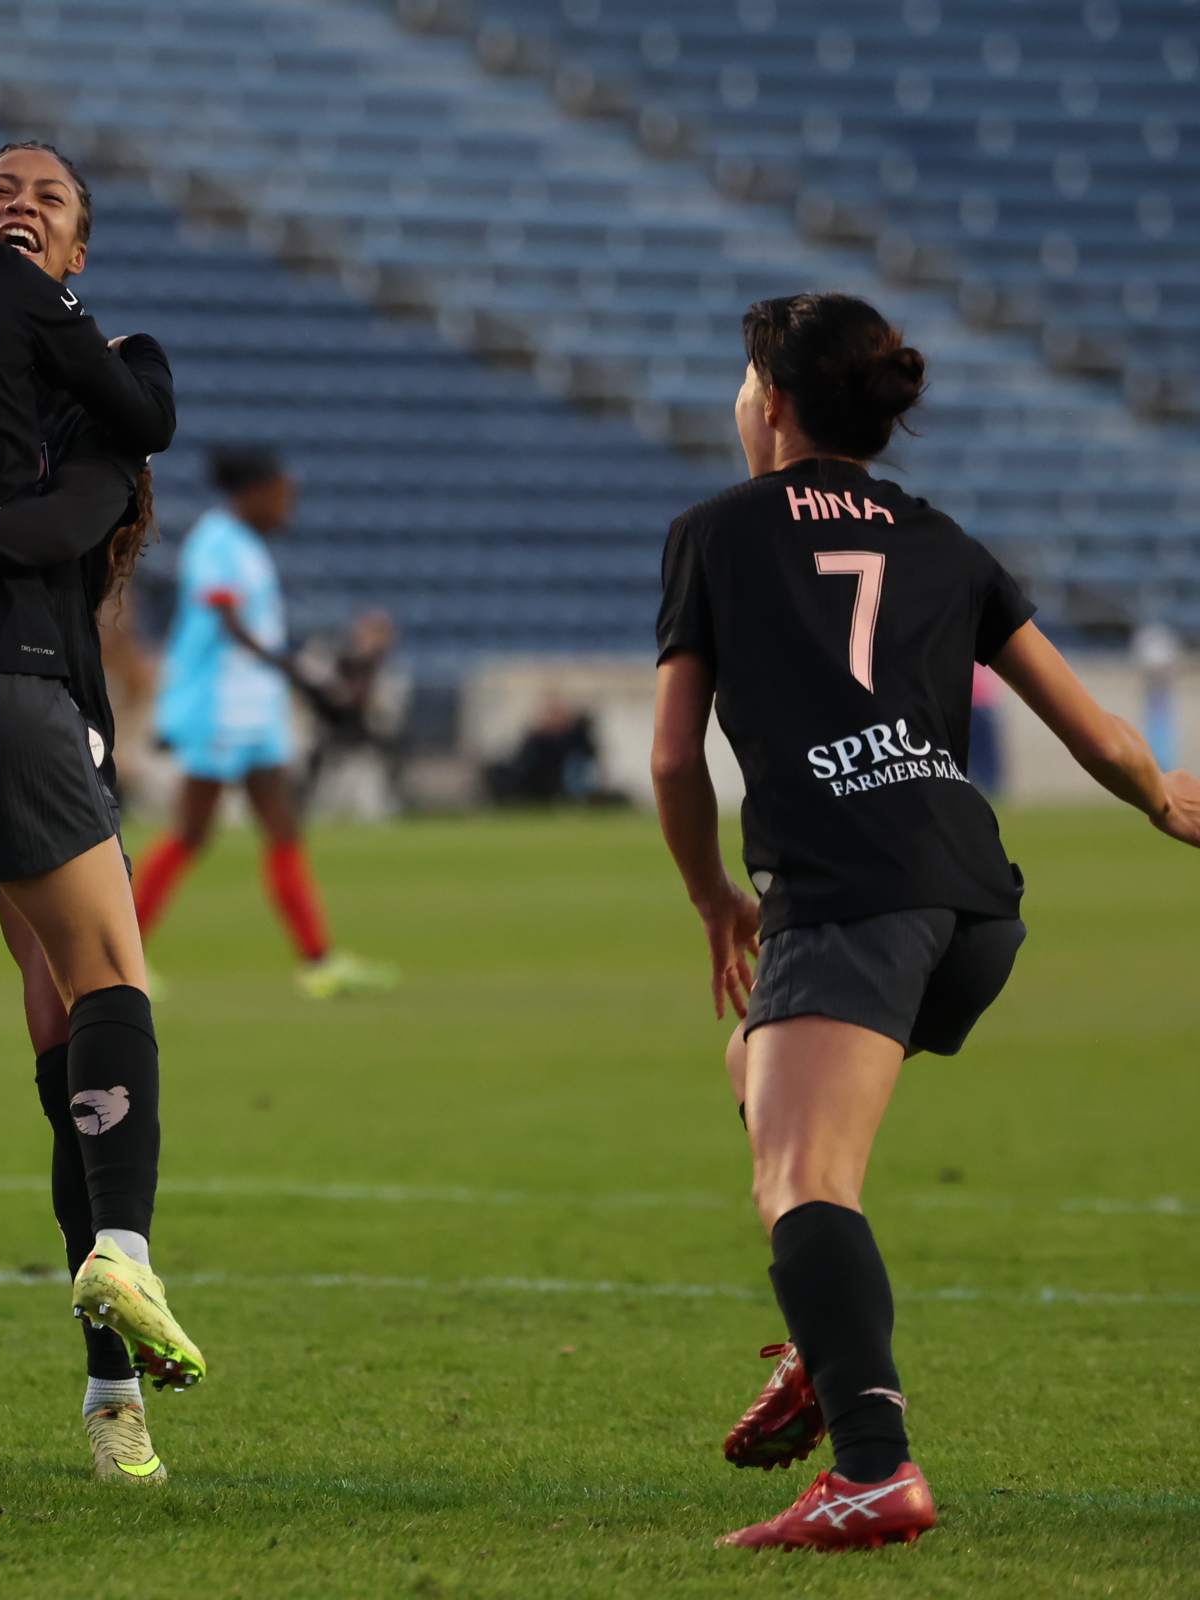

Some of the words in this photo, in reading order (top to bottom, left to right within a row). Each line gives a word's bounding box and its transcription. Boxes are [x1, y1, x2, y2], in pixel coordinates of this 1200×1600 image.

[786, 486, 894, 524] HINA
[814, 551, 885, 694] 7
[830, 759, 932, 797] FARMERS
